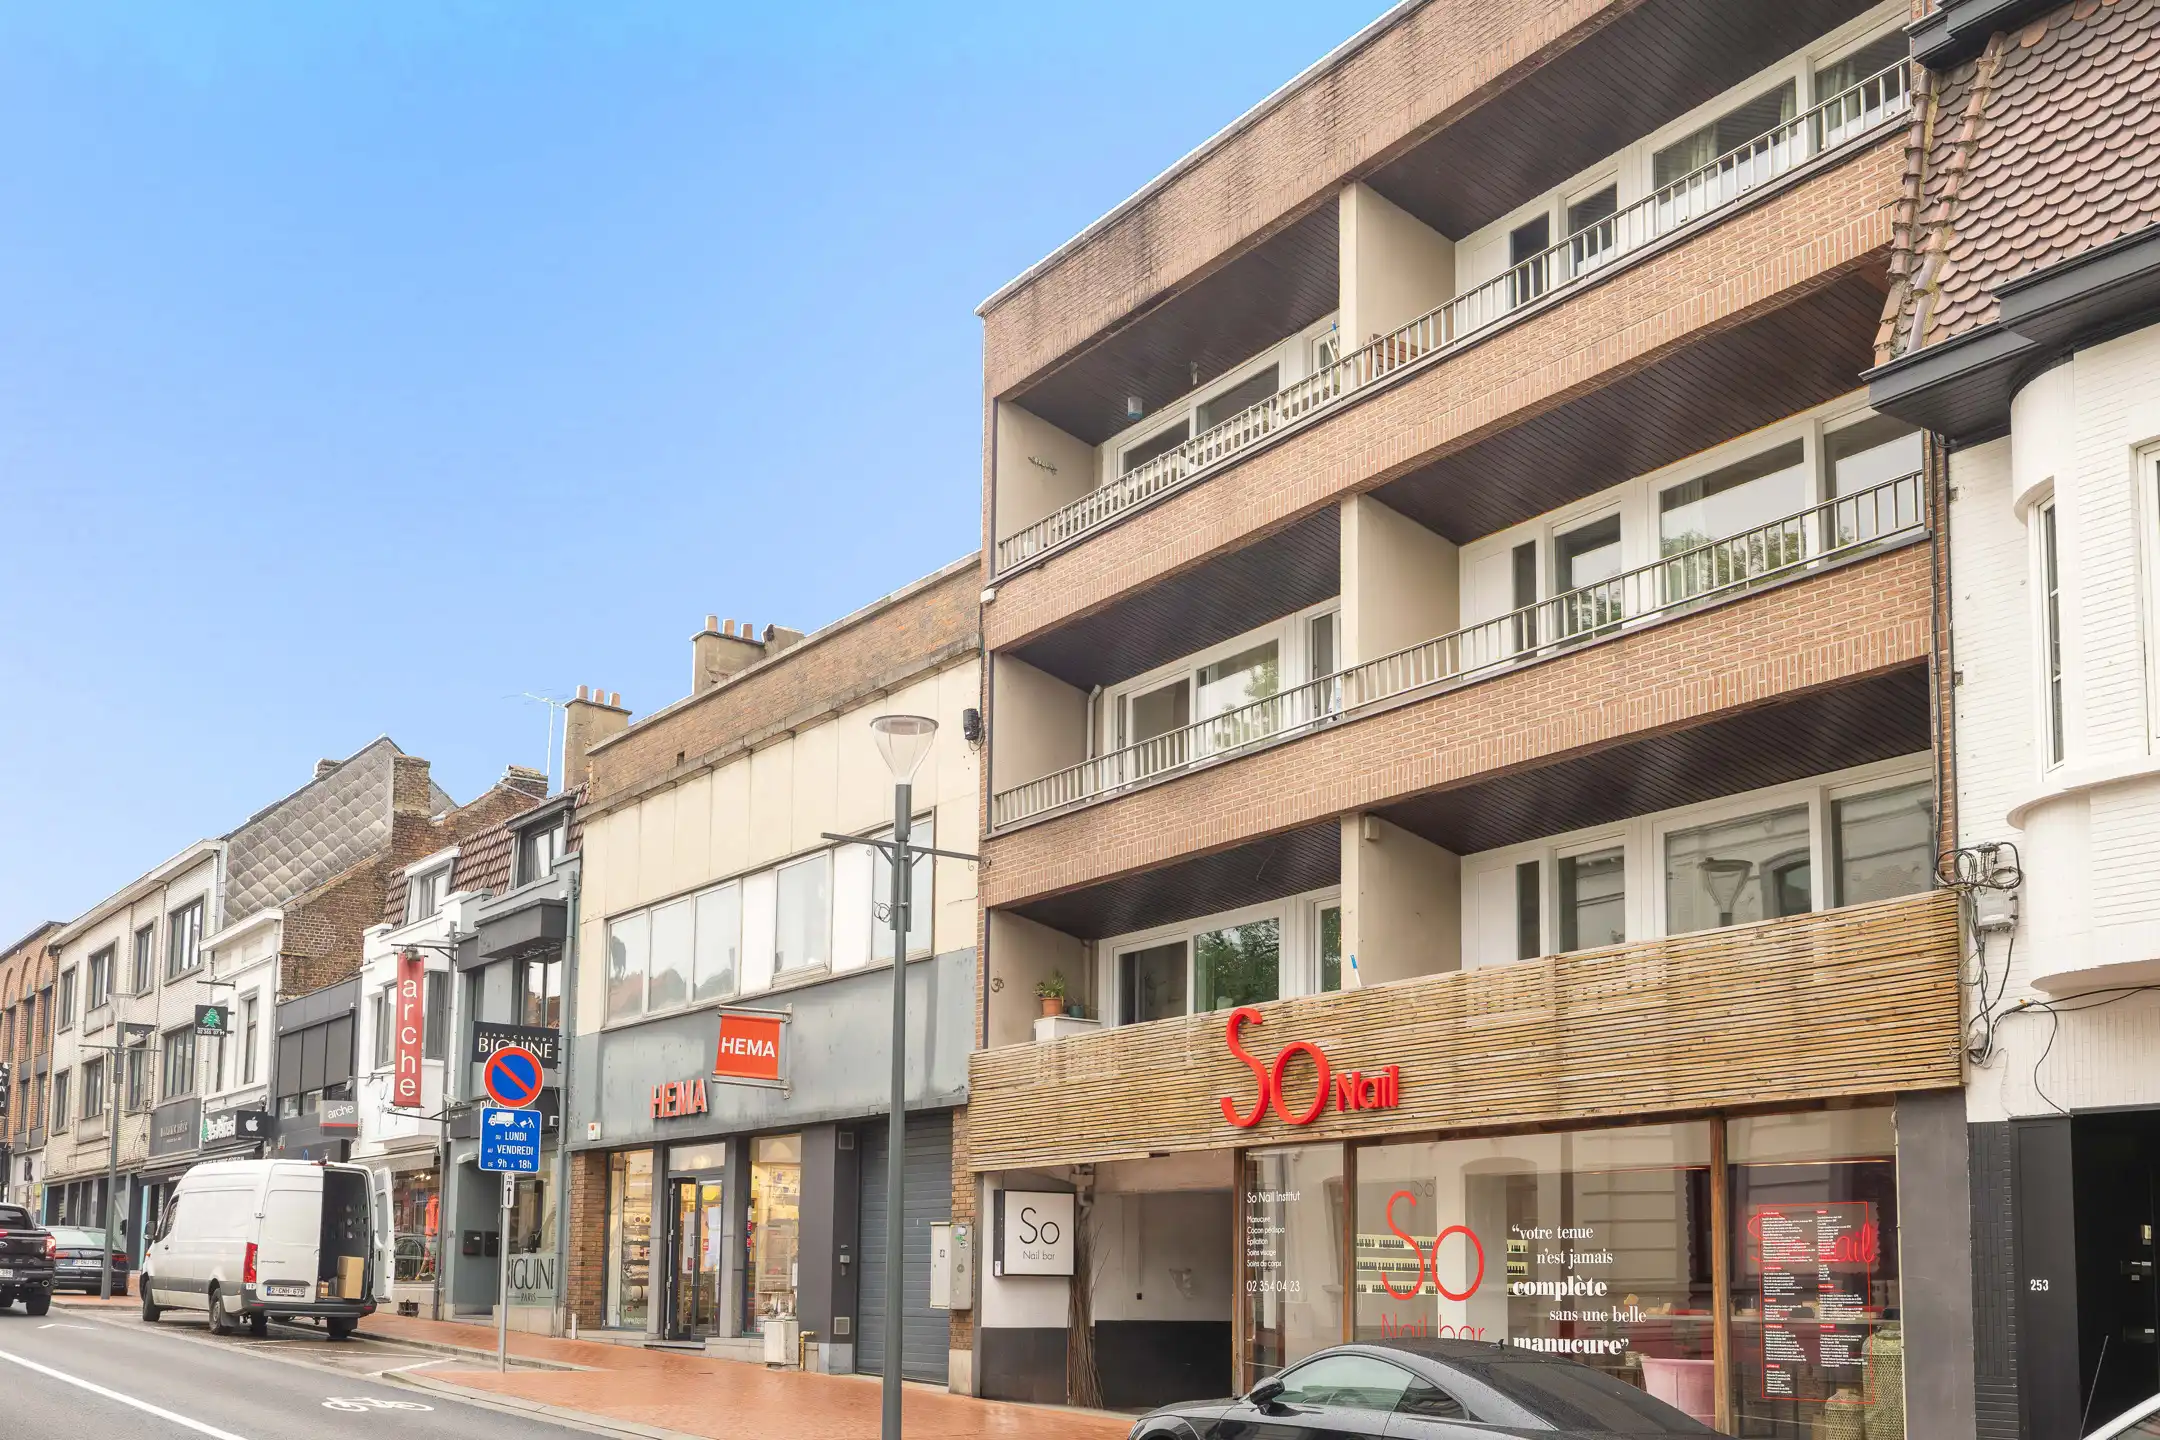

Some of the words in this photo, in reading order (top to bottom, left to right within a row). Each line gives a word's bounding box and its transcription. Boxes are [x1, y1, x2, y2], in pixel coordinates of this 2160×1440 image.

[400, 979, 417, 1097] arche
[720, 1036, 776, 1058] HEMA
[1335, 1064, 1399, 1112] Nail
[650, 1078, 708, 1119] HEMA
[327, 1103, 355, 1119] arche
[504, 1131, 527, 1142] LUNDI
[496, 1144, 534, 1156] VENDREDI
[497, 1158, 508, 1168] 9h
[518, 1159, 532, 1170] 18h
[1247, 1191, 1257, 1204] So
[1258, 1191, 1275, 1203] Nail
[1276, 1190, 1301, 1201] Institut
[1019, 1206, 1060, 1245] So
[1246, 1215, 1271, 1223] Manucure
[1246, 1226, 1264, 1235] Cocon
[1556, 1225, 1594, 1239] tenue
[1022, 1249, 1040, 1260] Nail
[1042, 1250, 1056, 1260] bar
[1246, 1247, 1260, 1257] Soins
[1536, 1247, 1566, 1264] n’est
[1567, 1247, 1614, 1270] jamais
[1246, 1259, 1260, 1268] Soins
[1268, 1260, 1282, 1269] corps
[1246, 1280, 1258, 1293] 02
[1259, 1280, 1275, 1292] 354
[1276, 1280, 1287, 1292] 04
[1289, 1280, 1300, 1292] 23
[1512, 1274, 1608, 1302] complète
[2030, 1278, 2049, 1291] 253
[1549, 1309, 1578, 1321] sans
[1582, 1309, 1609, 1322] une
[1612, 1305, 1648, 1323] belle
